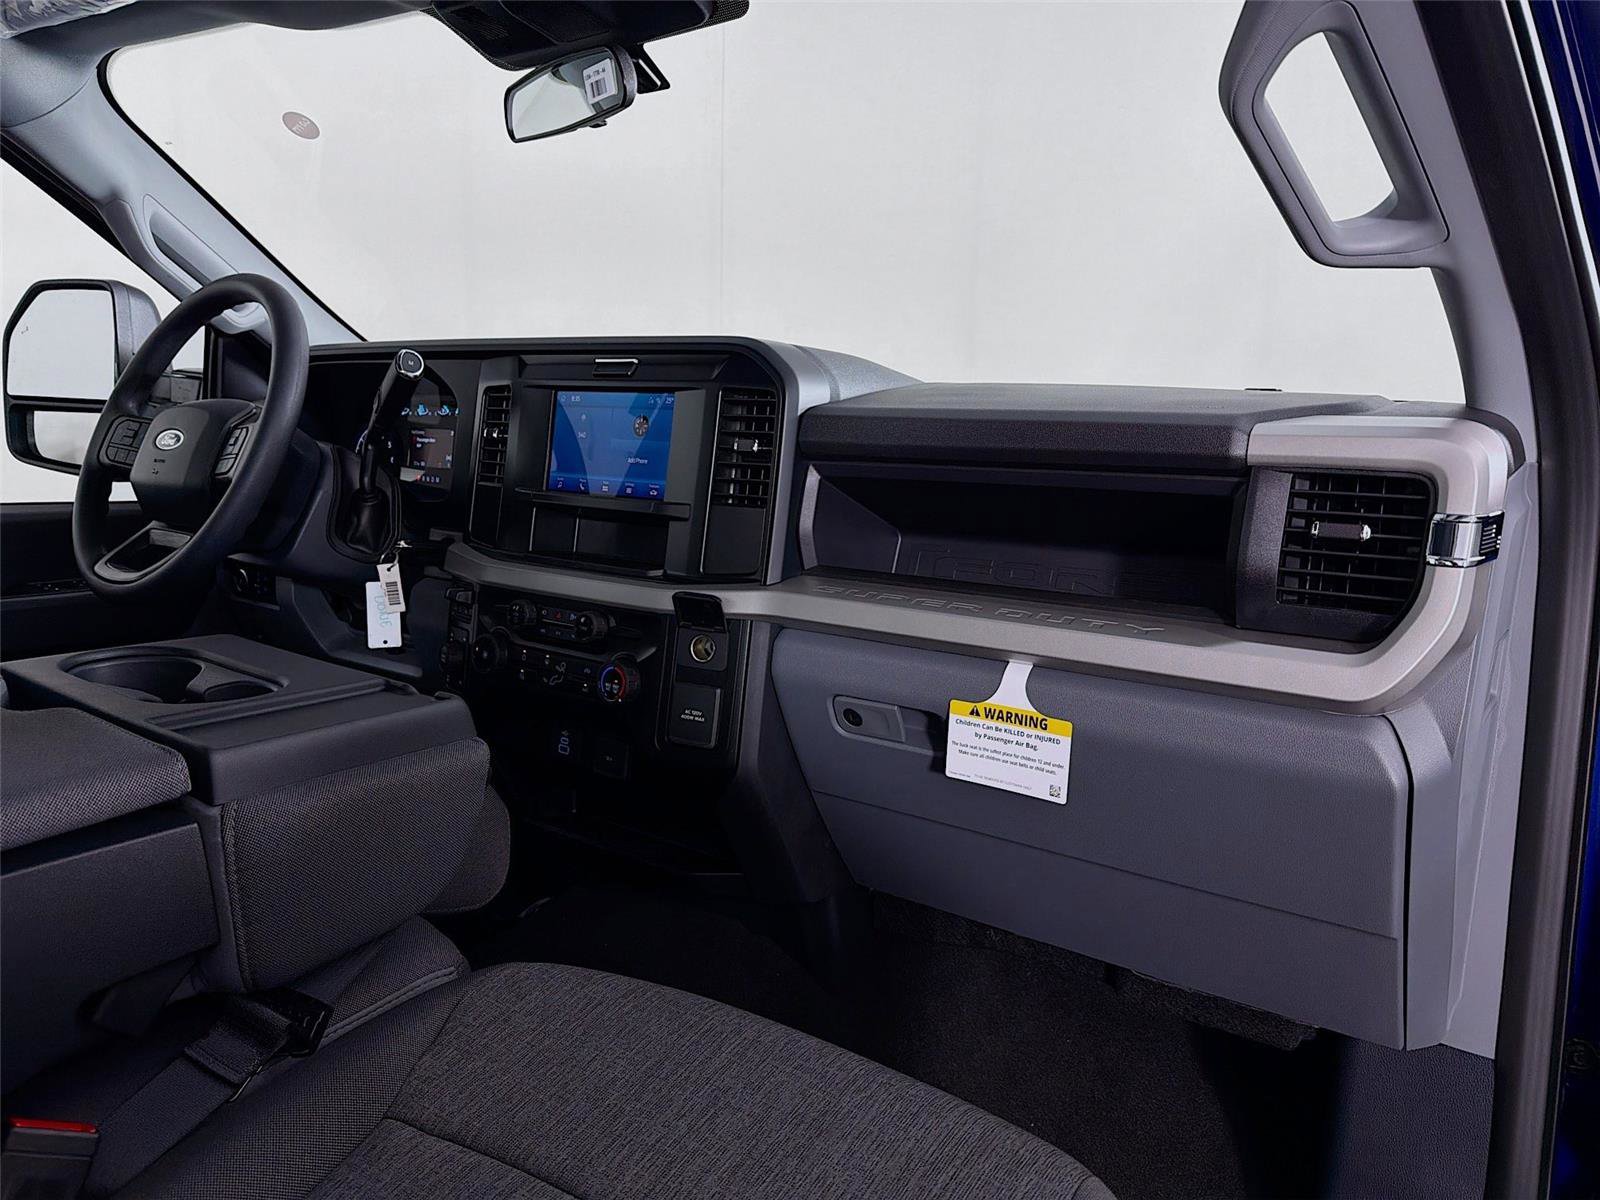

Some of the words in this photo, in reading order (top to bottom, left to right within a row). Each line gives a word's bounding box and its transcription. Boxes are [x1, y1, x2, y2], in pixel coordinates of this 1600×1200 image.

[814, 584, 984, 613] SUPER
[994, 606, 1166, 635] DUTY
[983, 706, 1048, 731] WARNING
[955, 718, 981, 728] Children
[982, 723, 993, 731] Can
[1003, 728, 1025, 737] KILLED
[1034, 734, 1061, 745] INJURED
[974, 731, 982, 740] by
[983, 733, 1014, 745] Passenger
[1020, 755, 1037, 763] children
